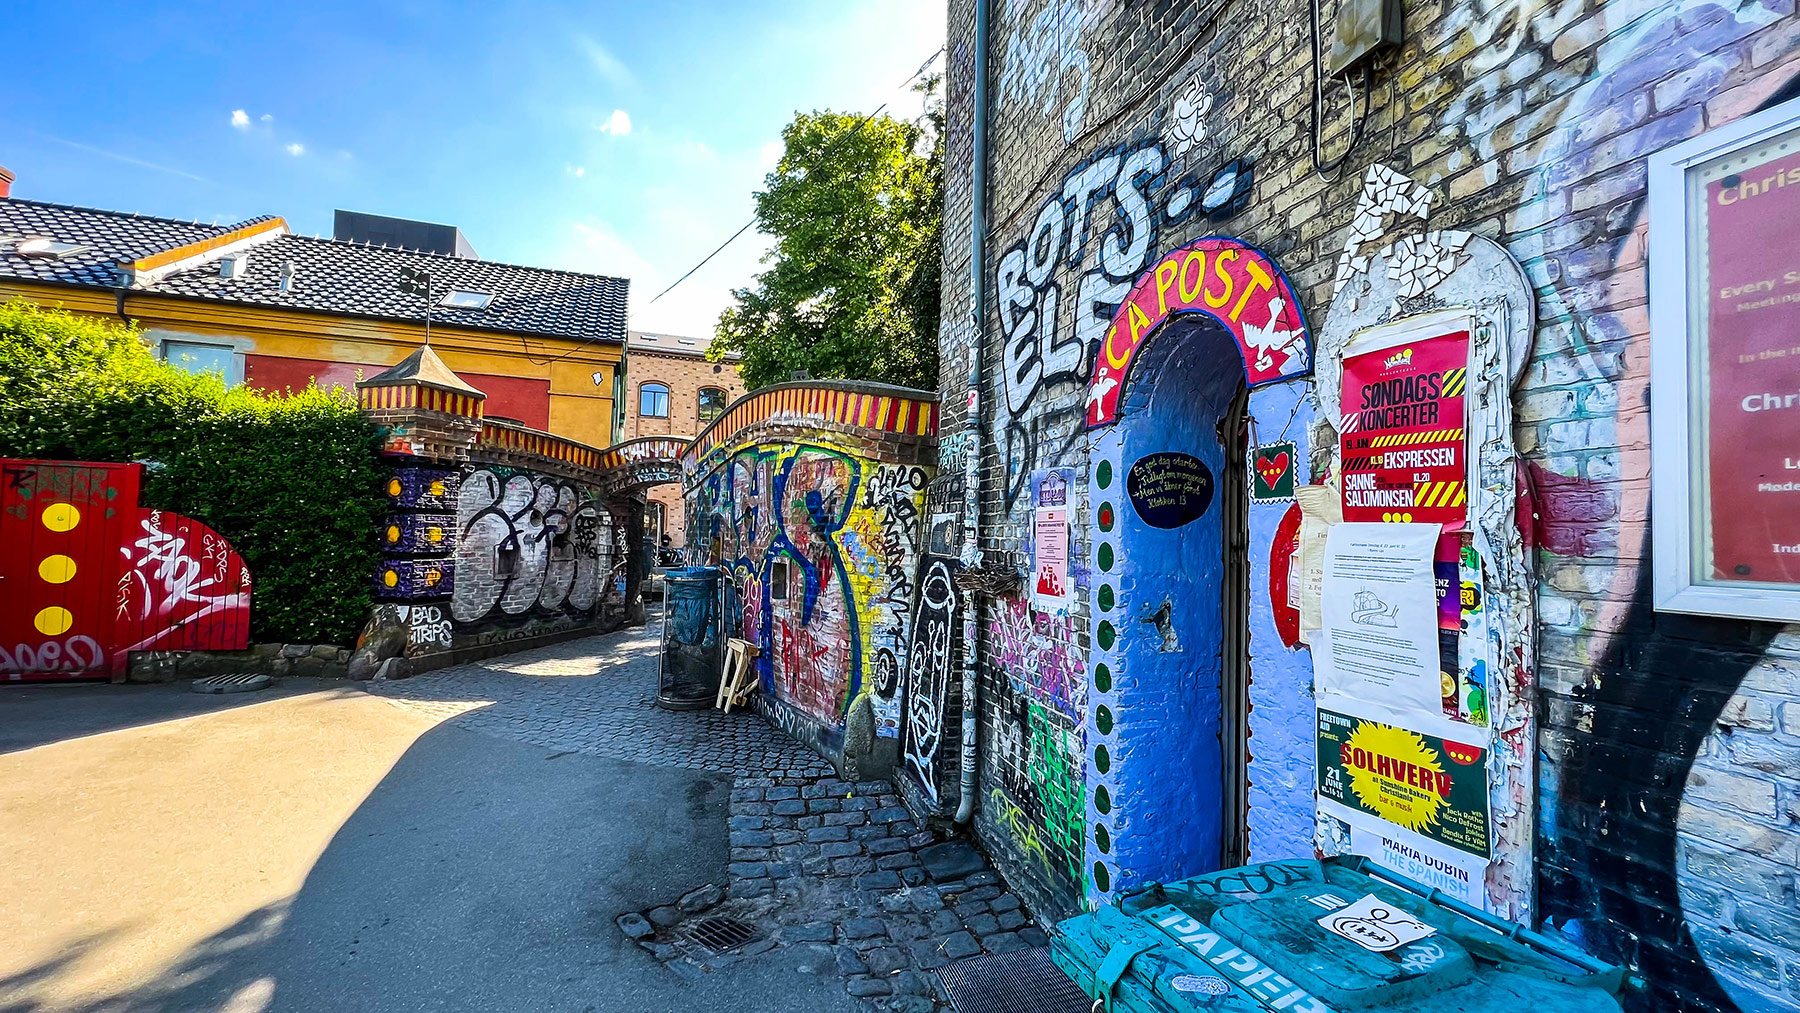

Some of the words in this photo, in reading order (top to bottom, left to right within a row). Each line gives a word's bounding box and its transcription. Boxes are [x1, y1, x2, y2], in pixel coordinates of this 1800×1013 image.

[1154, 249, 1274, 323] POST
[1720, 279, 1777, 299] Every
[1361, 373, 1441, 409] SØNDAGS
[1359, 401, 1439, 431] KONCERTER
[1145, 458, 1157, 473] god
[1158, 456, 1171, 469] dag
[1384, 447, 1455, 469] EKSPRESSEN
[1345, 473, 1377, 491] SANNE
[1345, 489, 1414, 508] SALOMONSEN
[411, 605, 442, 625] BAD
[1320, 712, 1351, 728] FREETOWN
[1320, 721, 1330, 732] AID
[1326, 766, 1340, 782] 21
[1340, 743, 1452, 798] SOLHVERV
[1325, 777, 1343, 791] JUNE
[1380, 778, 1408, 793] Sunshine
[1409, 788, 1431, 802] Bakery
[1379, 794, 1389, 804] bar
[1395, 802, 1412, 813] musik
[1380, 785, 1413, 803] Christiania
[1443, 812, 1457, 823] Nico
[1447, 808, 1462, 817] Jack
[1382, 837, 1421, 862] MARIA
[1425, 854, 1469, 883] DUBIN
[1383, 848, 1405, 869] THE
[1408, 860, 1469, 898] SPANISH
